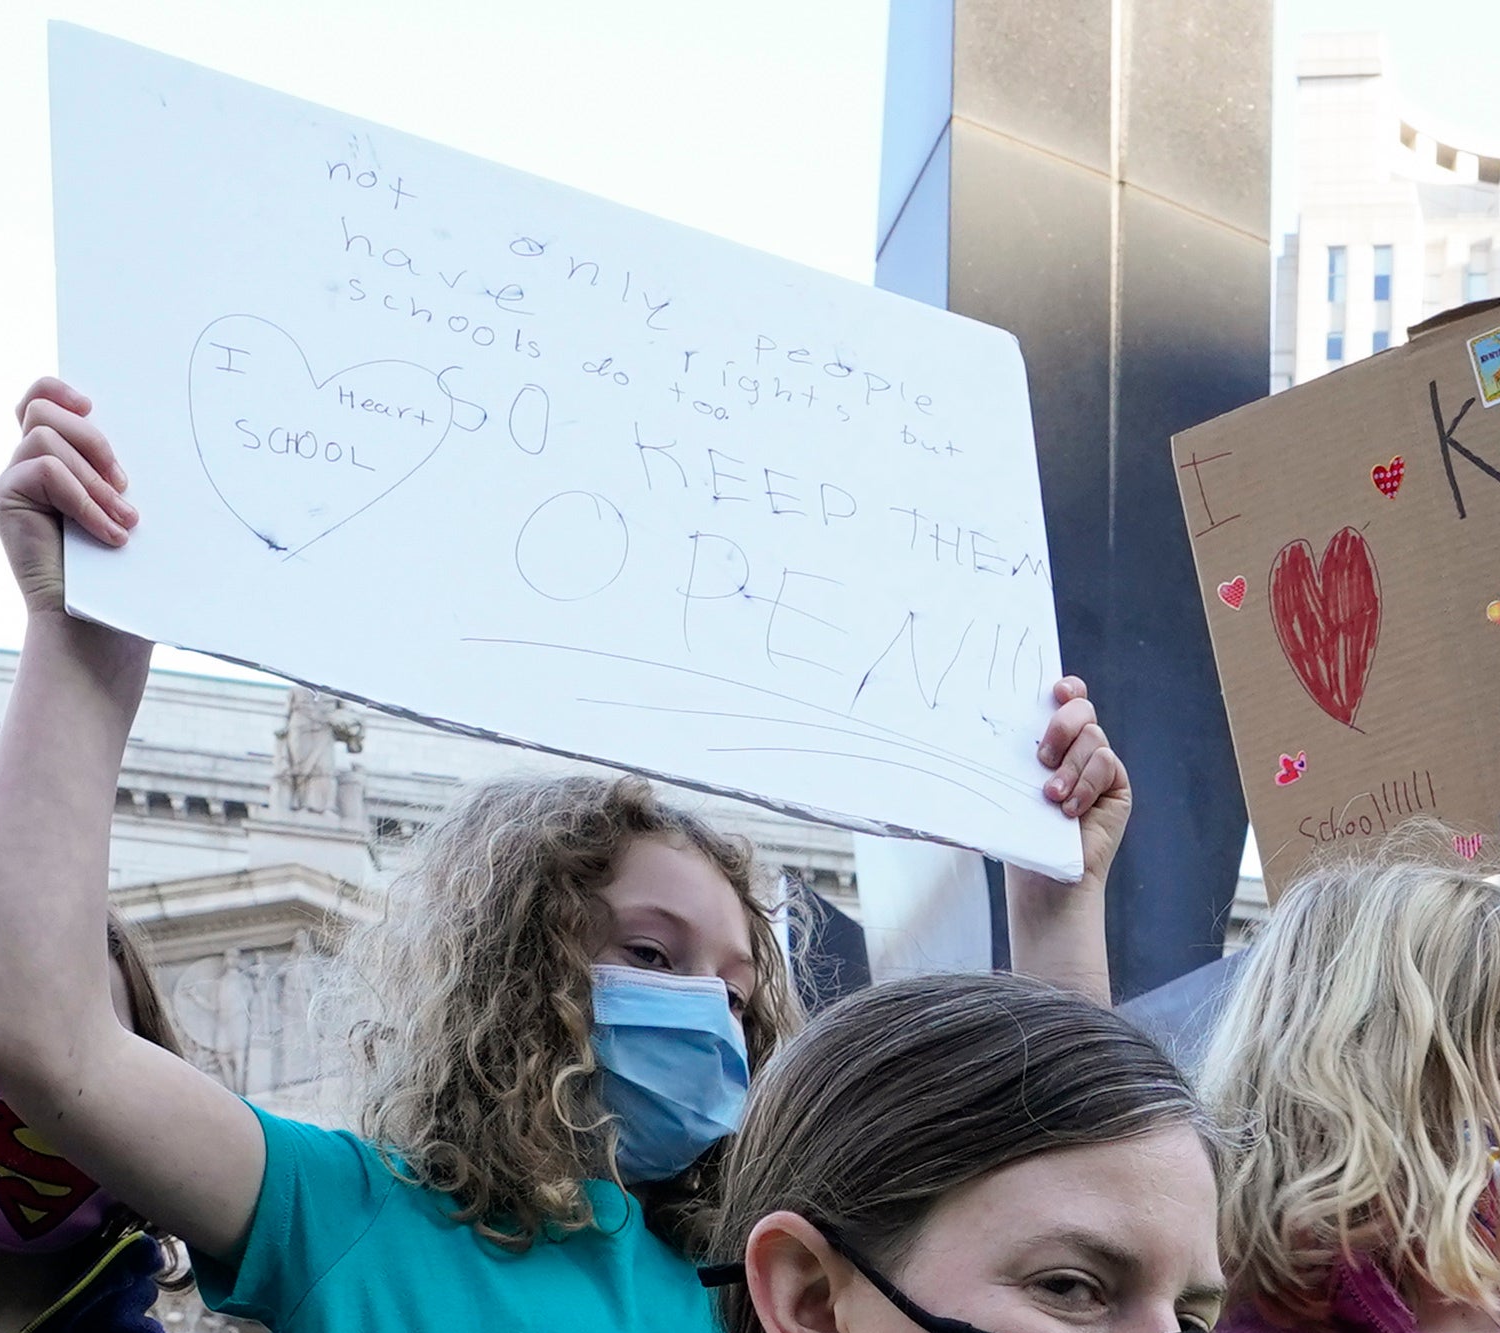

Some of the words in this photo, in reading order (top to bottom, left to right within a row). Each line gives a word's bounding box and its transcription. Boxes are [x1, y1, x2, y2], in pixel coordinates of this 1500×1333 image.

[326, 160, 417, 210] not
[509, 236, 671, 331] only
[755, 334, 934, 416] people
[208, 342, 252, 377] I
[341, 216, 536, 316] have
[684, 350, 851, 422] rights
[899, 424, 965, 456] but
[582, 357, 630, 386] do
[338, 384, 435, 427] Heart
[231, 416, 377, 473] SCHOOL
[634, 421, 858, 526] KEEP
[889, 506, 1055, 592] THEM
[1180, 451, 1242, 538] I
